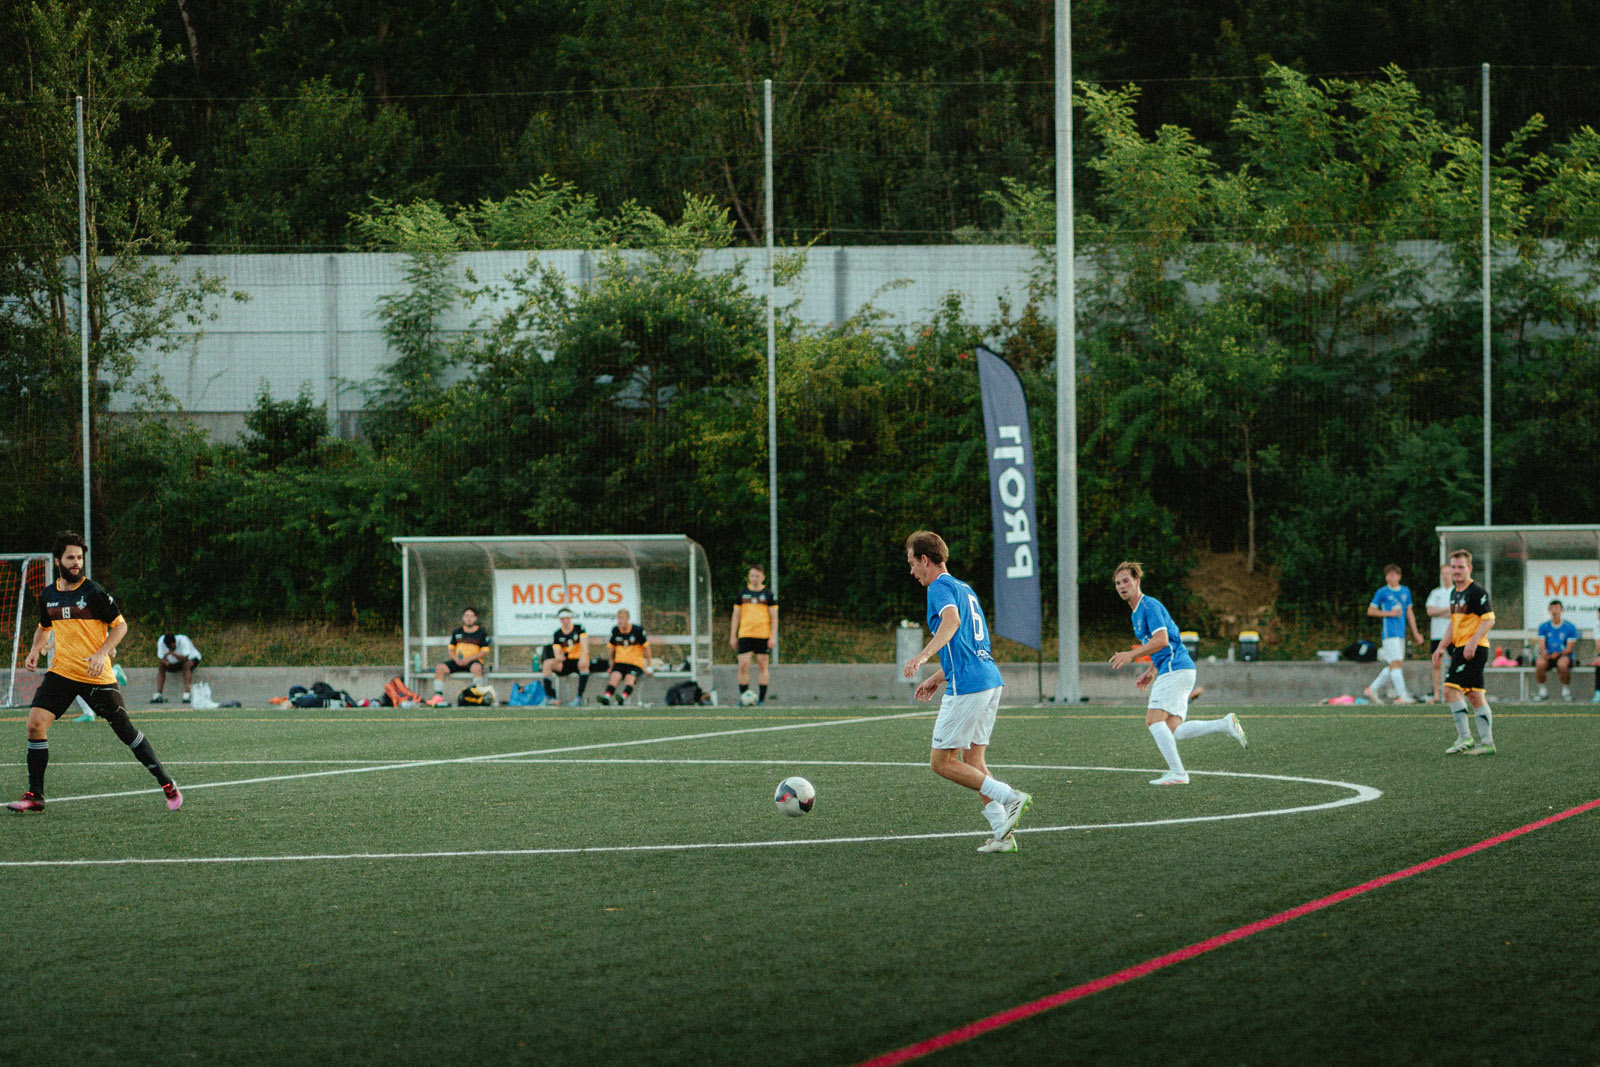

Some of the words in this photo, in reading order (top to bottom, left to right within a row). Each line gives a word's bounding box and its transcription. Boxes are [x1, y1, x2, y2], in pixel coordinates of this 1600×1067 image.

[511, 583, 623, 604] MIGROS
[62, 606, 71, 619] 19
[968, 594, 984, 642] 6
